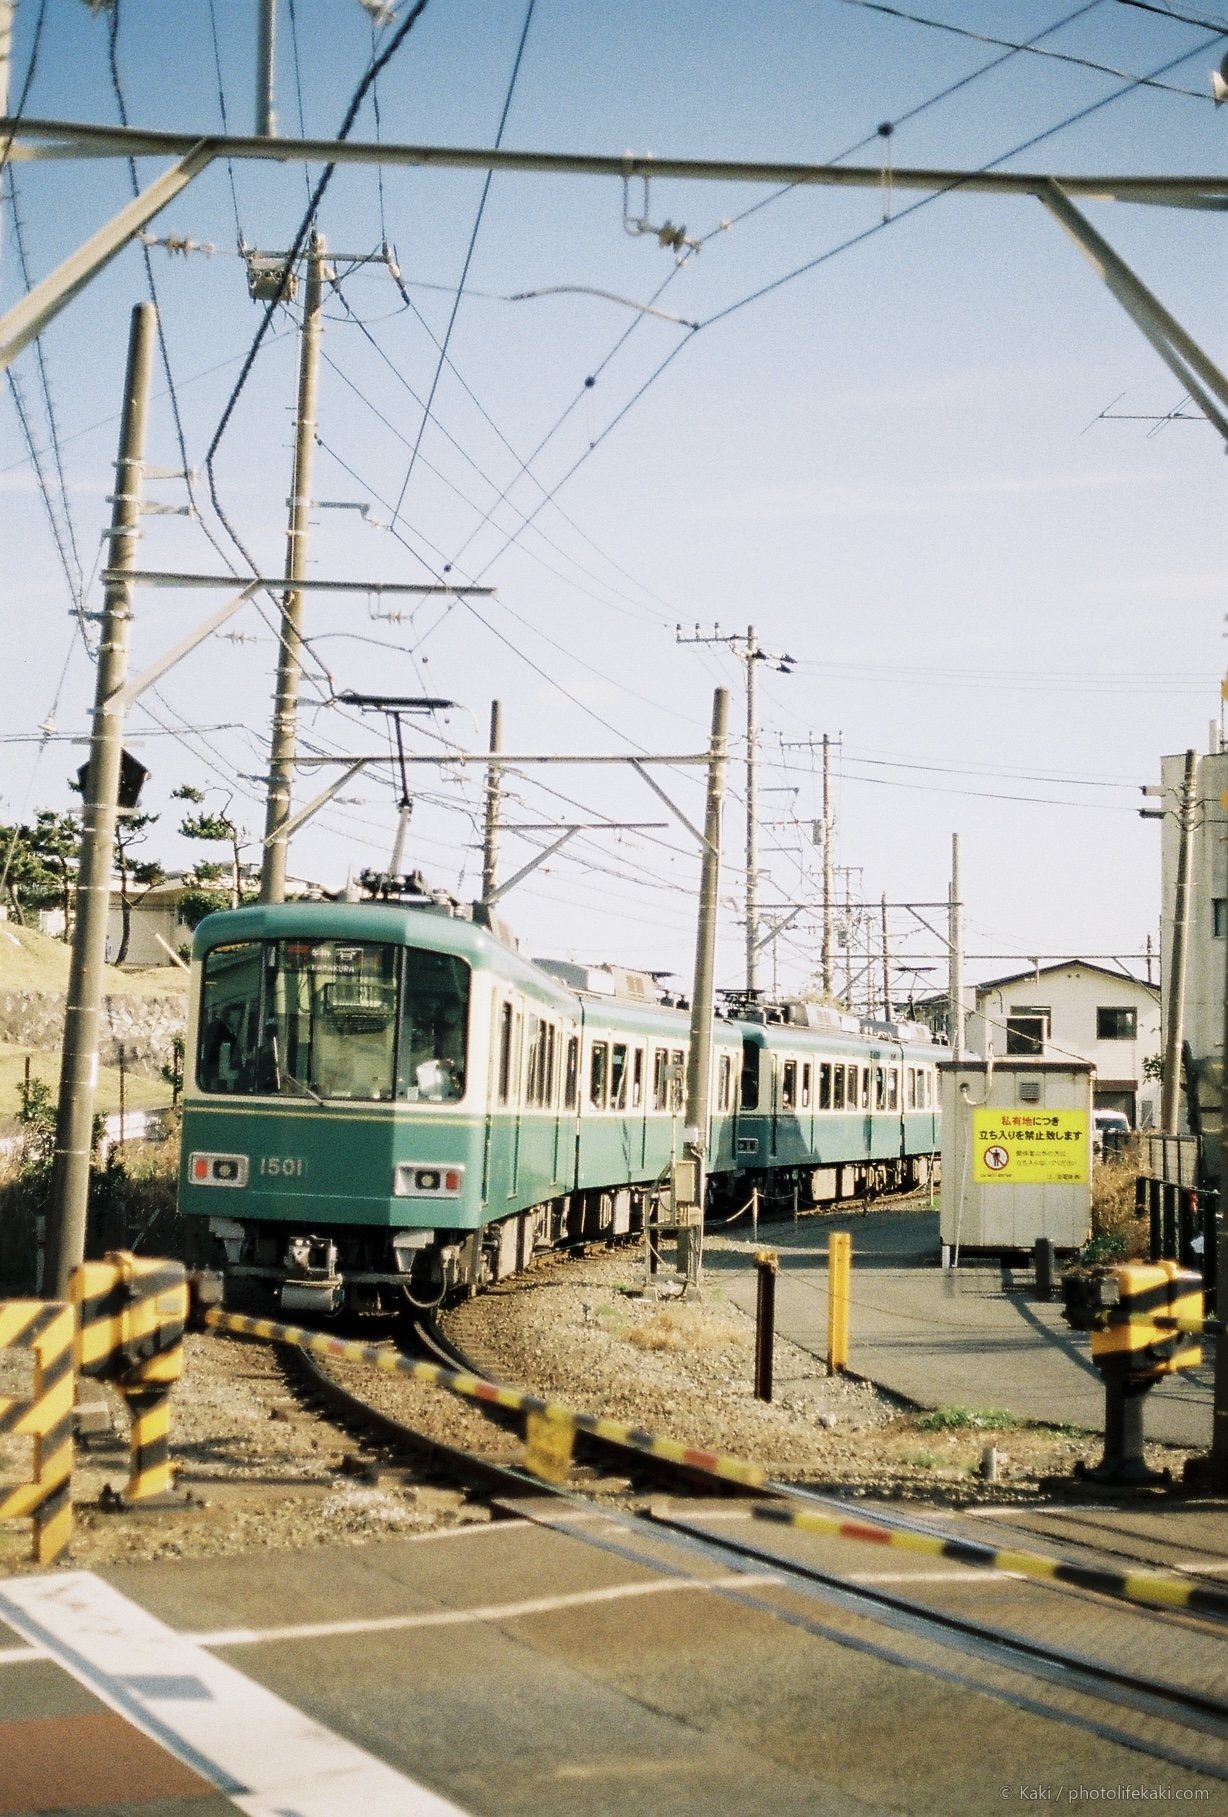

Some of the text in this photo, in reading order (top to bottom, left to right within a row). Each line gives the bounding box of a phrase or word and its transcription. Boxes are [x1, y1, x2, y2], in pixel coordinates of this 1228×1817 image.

[1001, 1116, 1060, 1126] 私有地につき
[979, 1130, 1083, 1141] 立ち入りを禁止致します
[260, 1157, 302, 1176] 1501
